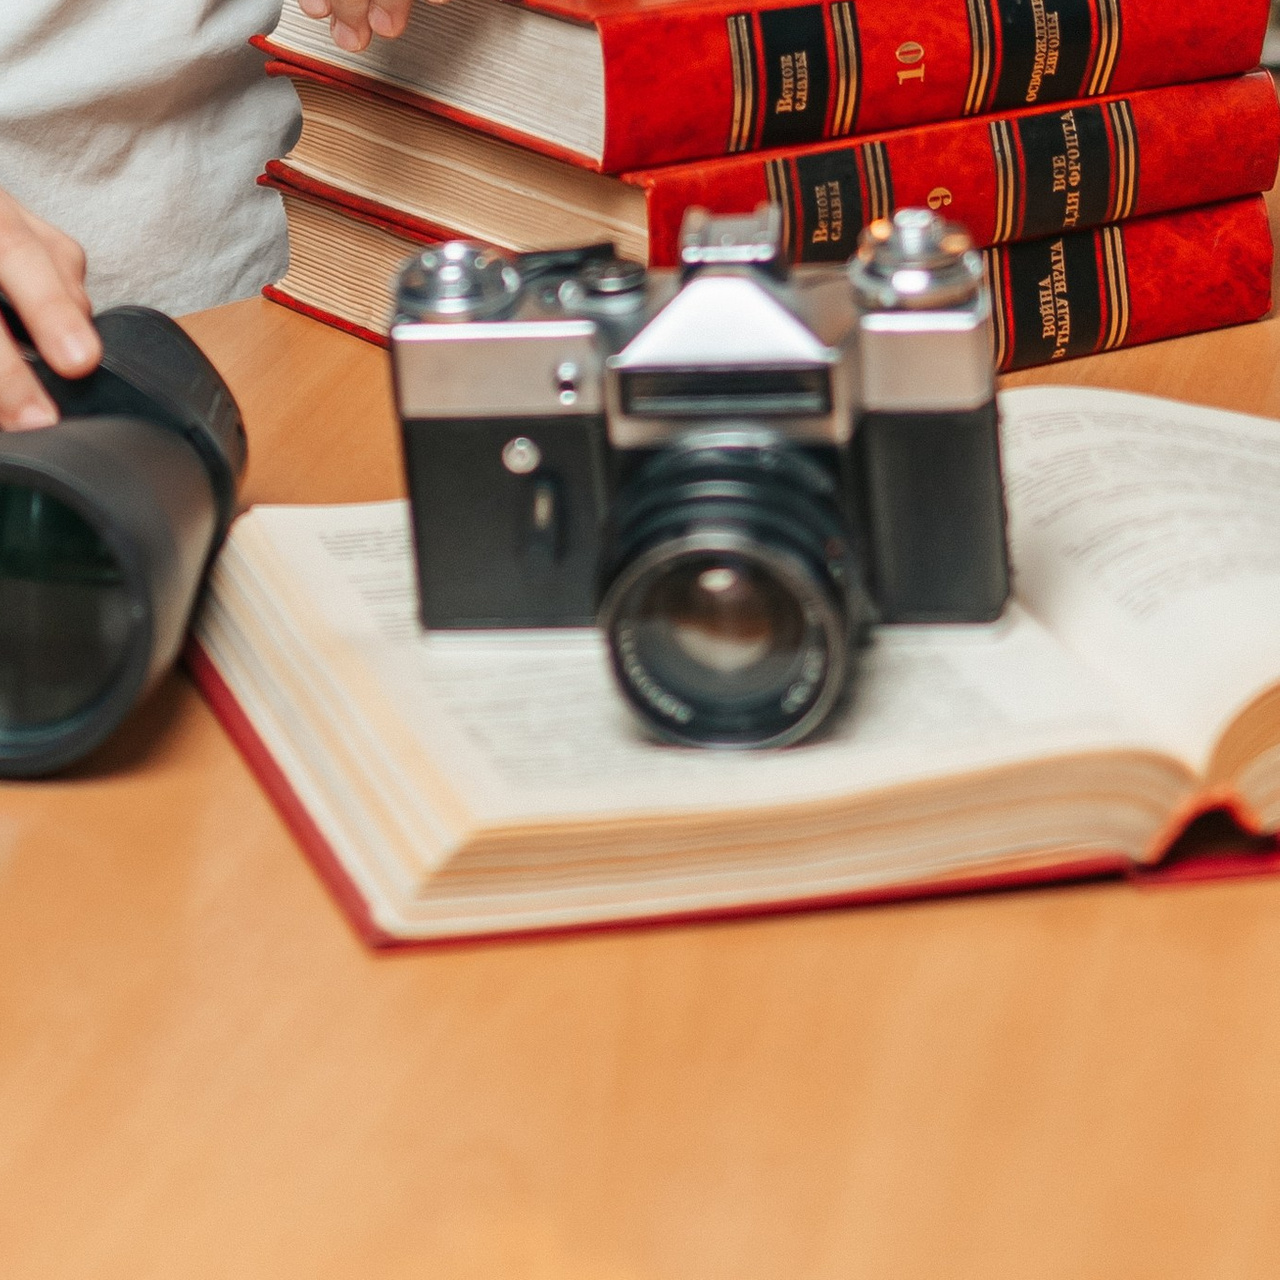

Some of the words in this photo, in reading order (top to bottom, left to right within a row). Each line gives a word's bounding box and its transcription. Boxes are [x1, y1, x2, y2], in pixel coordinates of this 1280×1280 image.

[895, 41, 925, 85] 10
[1044, 11, 1060, 76] ЕВРОПЫ
[1060, 109, 1081, 187] ФРОНТА
[1052, 155, 1066, 192] ВСЕ
[927, 187, 952, 210] 9
[1063, 191, 1080, 227] ДЛЯ
[1050, 238, 1067, 293] ВРАГА
[1038, 274, 1056, 339] ВОЙНА
[1055, 298, 1070, 347] ТЫЛУ
[1051, 347, 1066, 359] В
